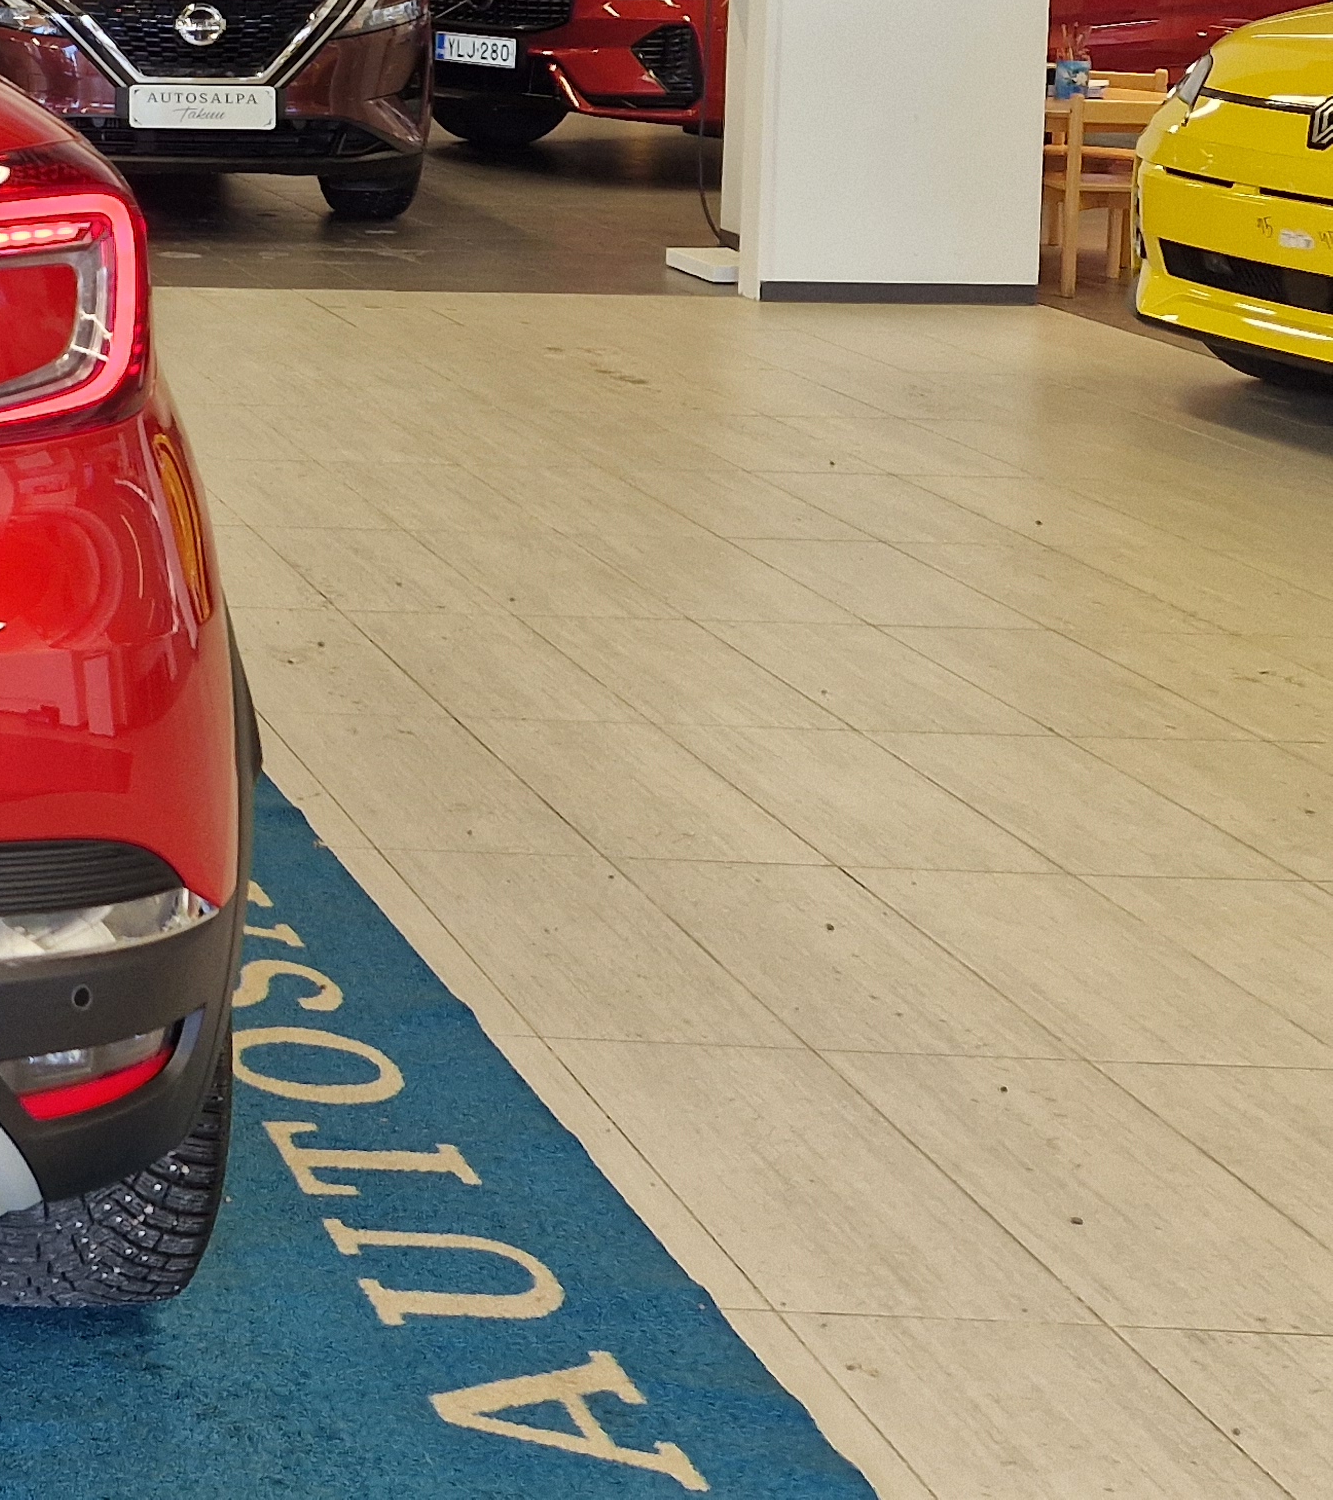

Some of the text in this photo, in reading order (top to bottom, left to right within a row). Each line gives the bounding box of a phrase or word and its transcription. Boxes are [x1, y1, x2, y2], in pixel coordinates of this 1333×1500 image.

[447, 39, 510, 62] YLJ-280
[147, 92, 258, 105] AUTOSALPA
[231, 879, 711, 1492] AUTOS
